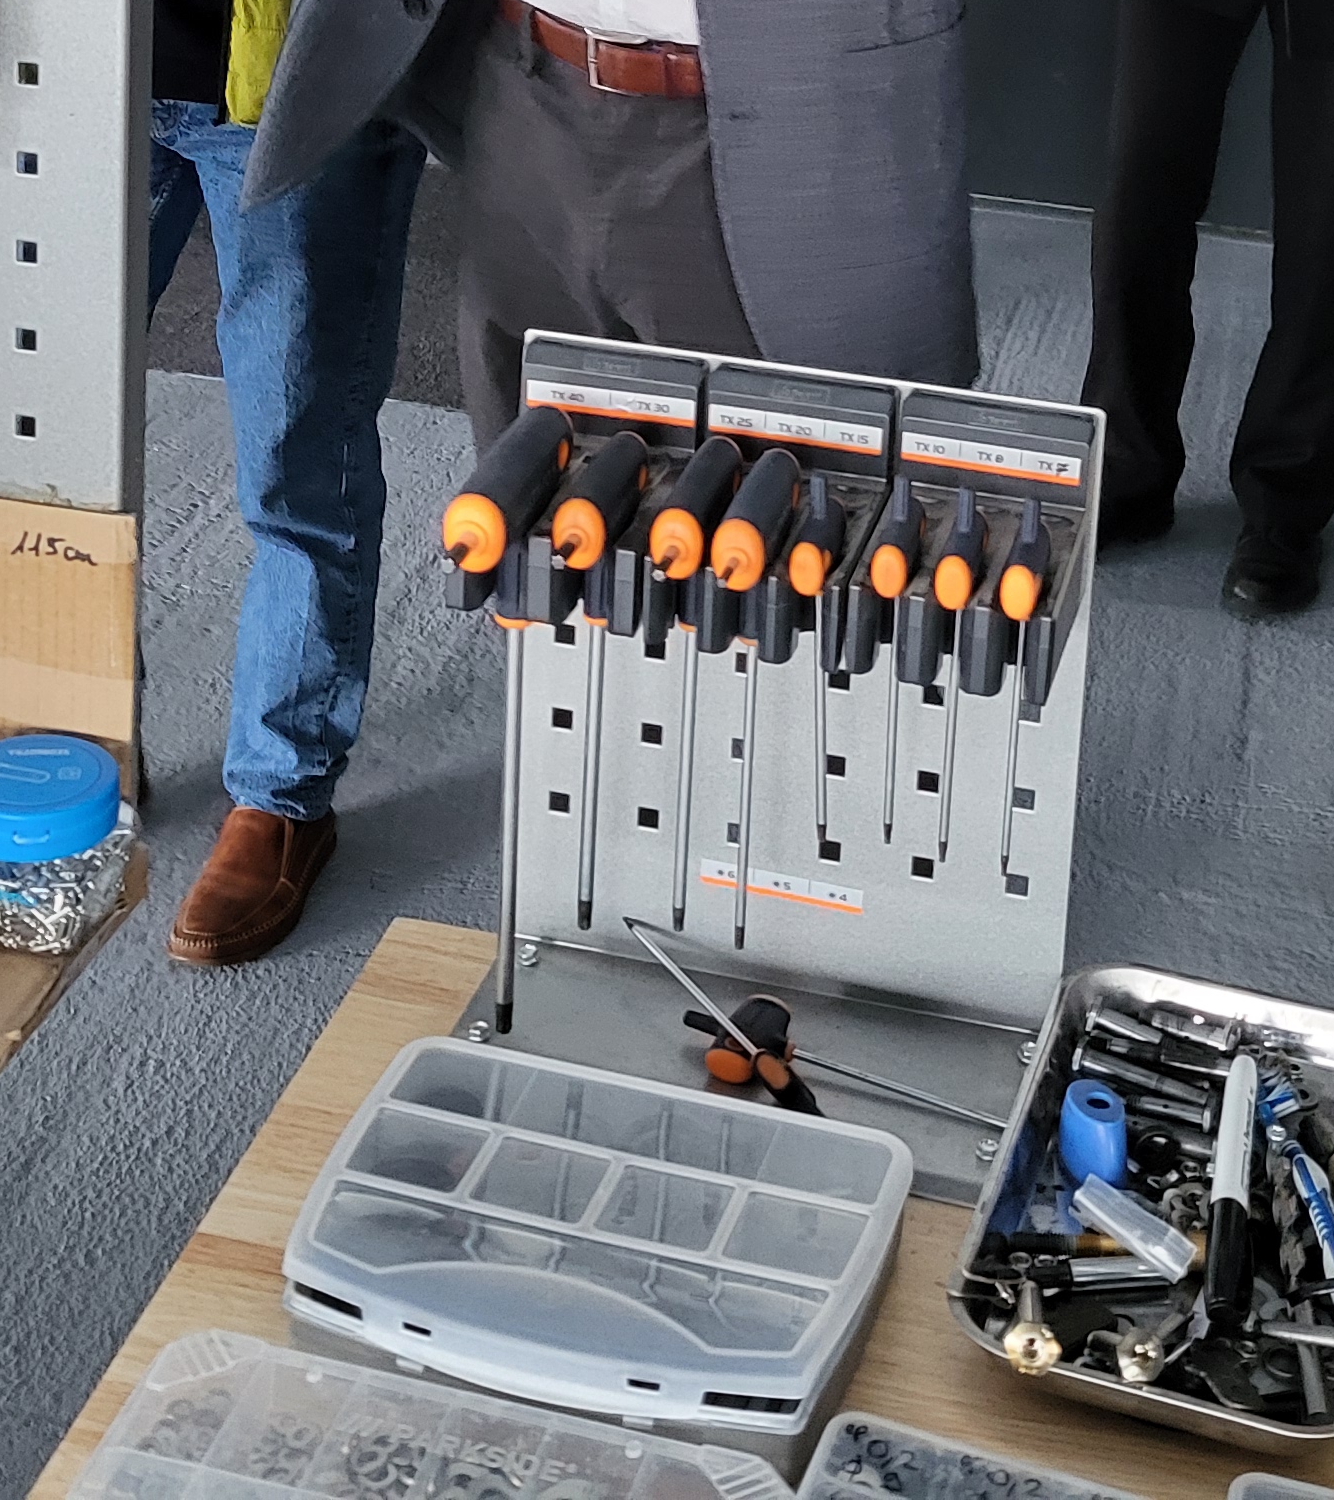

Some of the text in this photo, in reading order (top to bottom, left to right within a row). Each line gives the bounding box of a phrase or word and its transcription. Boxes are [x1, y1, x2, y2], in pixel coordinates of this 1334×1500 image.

[551, 390, 566, 400] TX
[637, 400, 670, 414] TX 30
[720, 414, 753, 428] TX 25
[778, 422, 812, 436] TX 20
[839, 431, 855, 443] TX
[915, 441, 931, 453] TX
[977, 450, 992, 462] TX
[1038, 459, 1054, 472] TX
[395, 1422, 563, 1484] PARKSIDE
